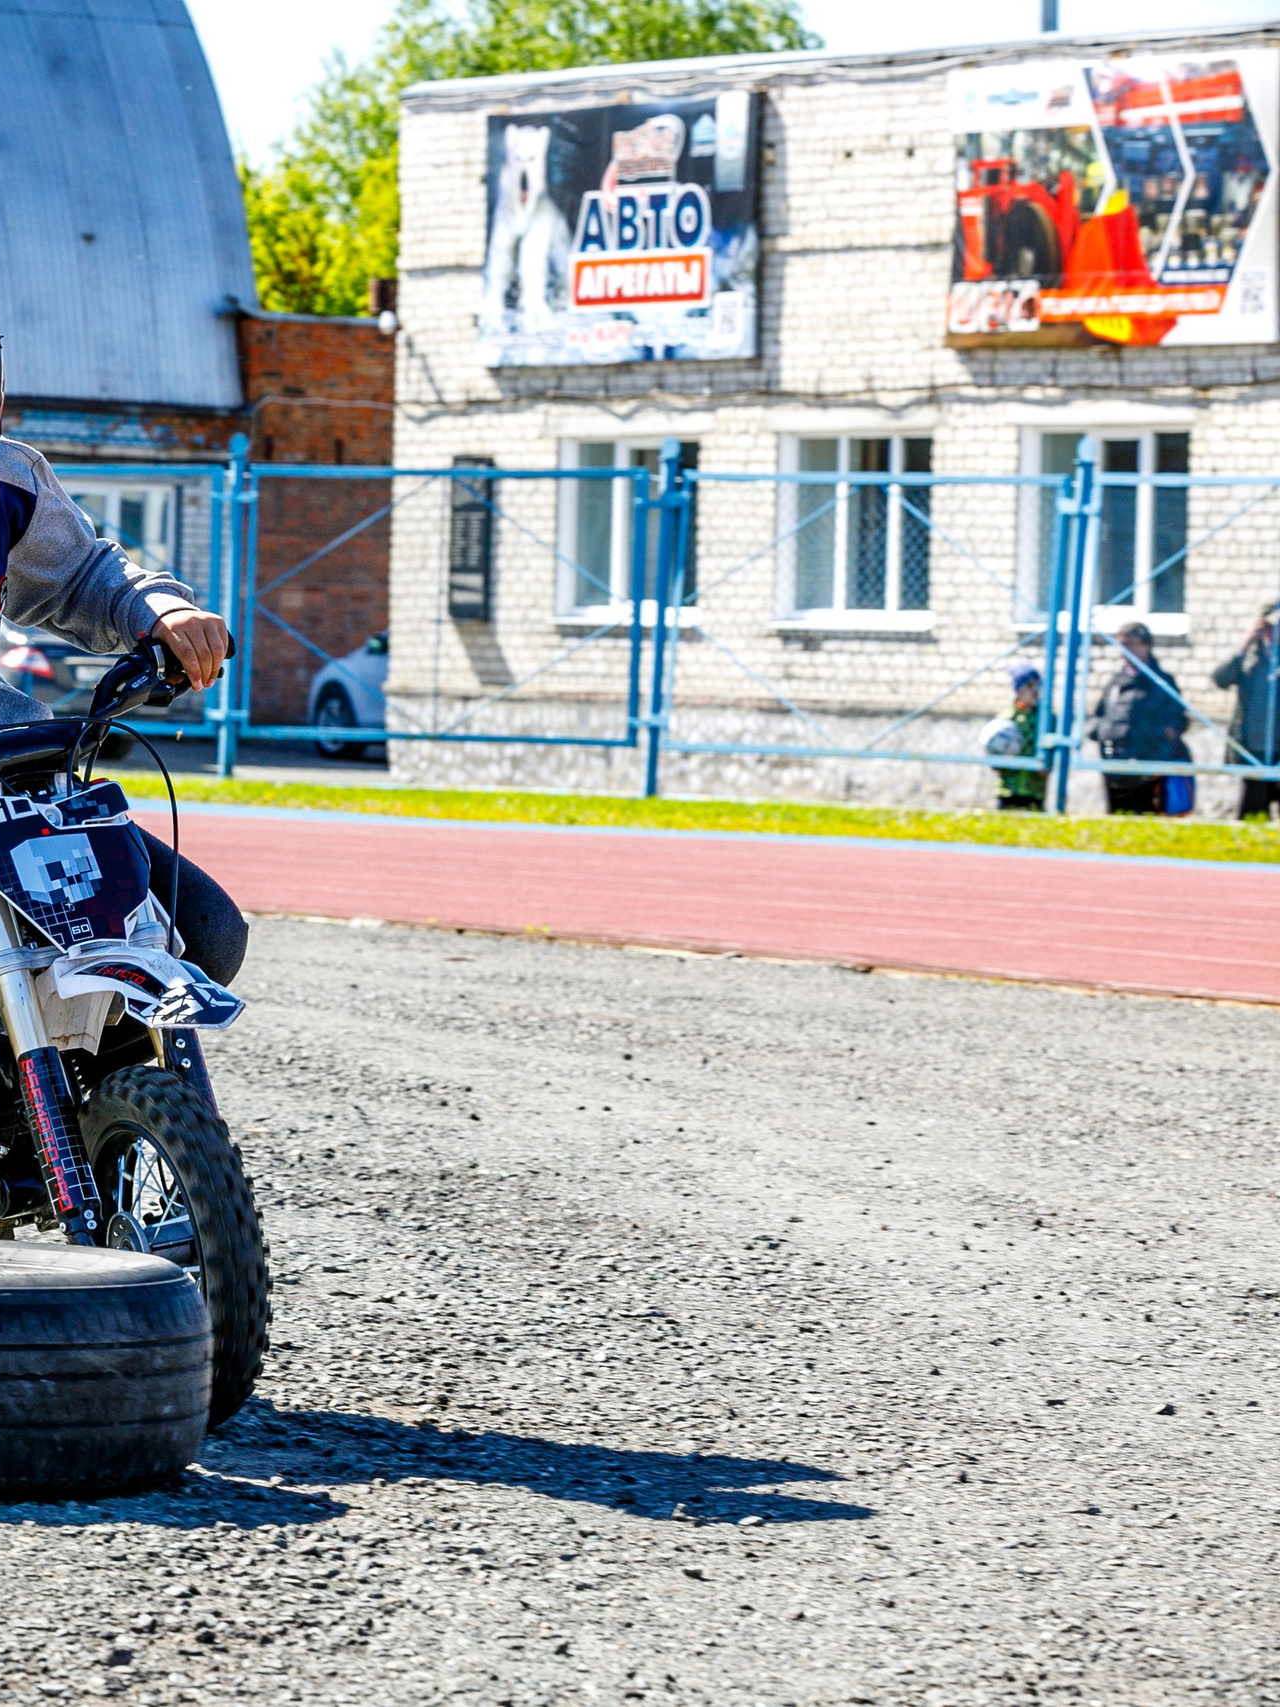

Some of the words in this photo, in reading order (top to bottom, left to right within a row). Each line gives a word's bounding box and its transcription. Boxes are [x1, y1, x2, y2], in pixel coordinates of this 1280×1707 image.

[579, 186, 706, 253] АВТО
[577, 260, 702, 300] АГРЕГАТЫ
[71, 923, 90, 934] 60
[20, 1058, 74, 1212] BSEMOTO.PRO
